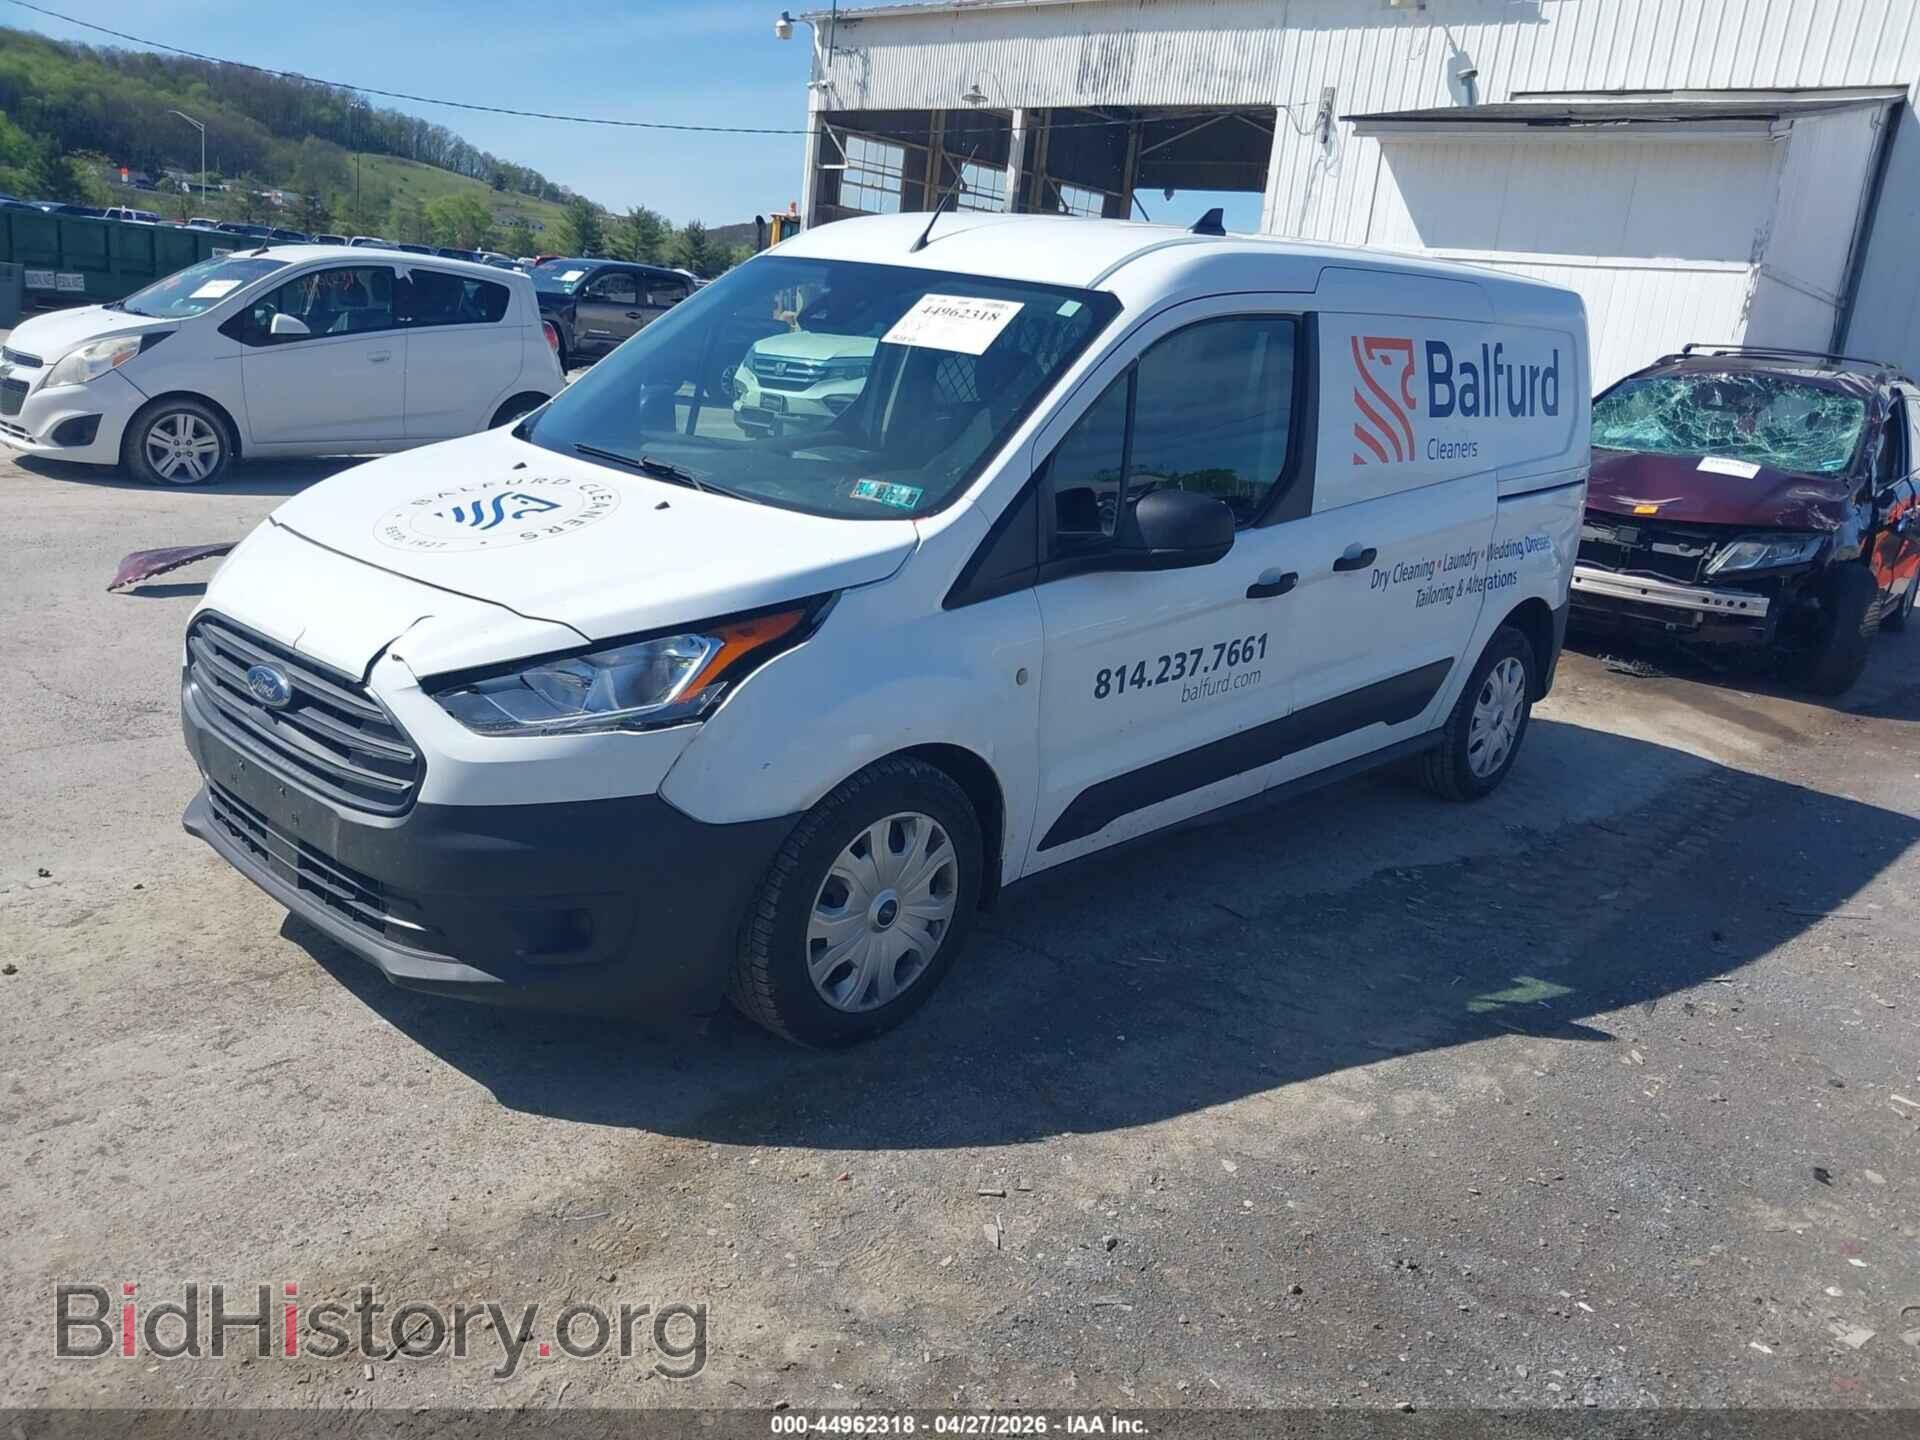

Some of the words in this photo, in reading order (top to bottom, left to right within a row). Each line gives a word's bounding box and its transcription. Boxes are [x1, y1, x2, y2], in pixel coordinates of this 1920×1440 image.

[921, 305, 1001, 321] 44962318
[1425, 340, 1559, 418] Balfurd
[1427, 438, 1478, 460] Cleaners
[411, 477, 571, 506] BALFURD
[520, 483, 612, 541] CLEANERS
[1371, 568, 1391, 592] Dry
[1393, 558, 1436, 584] Cleaning
[1443, 548, 1480, 573] Laundry
[1486, 539, 1524, 561] Wedding
[1415, 585, 1455, 608] Tailoring
[1456, 579, 1464, 597] &
[1465, 569, 1518, 596] Alterations
[251, 671, 276, 697] Ford
[1094, 632, 1268, 699] 814.237.7661
[1181, 669, 1262, 703] balfurd.com
